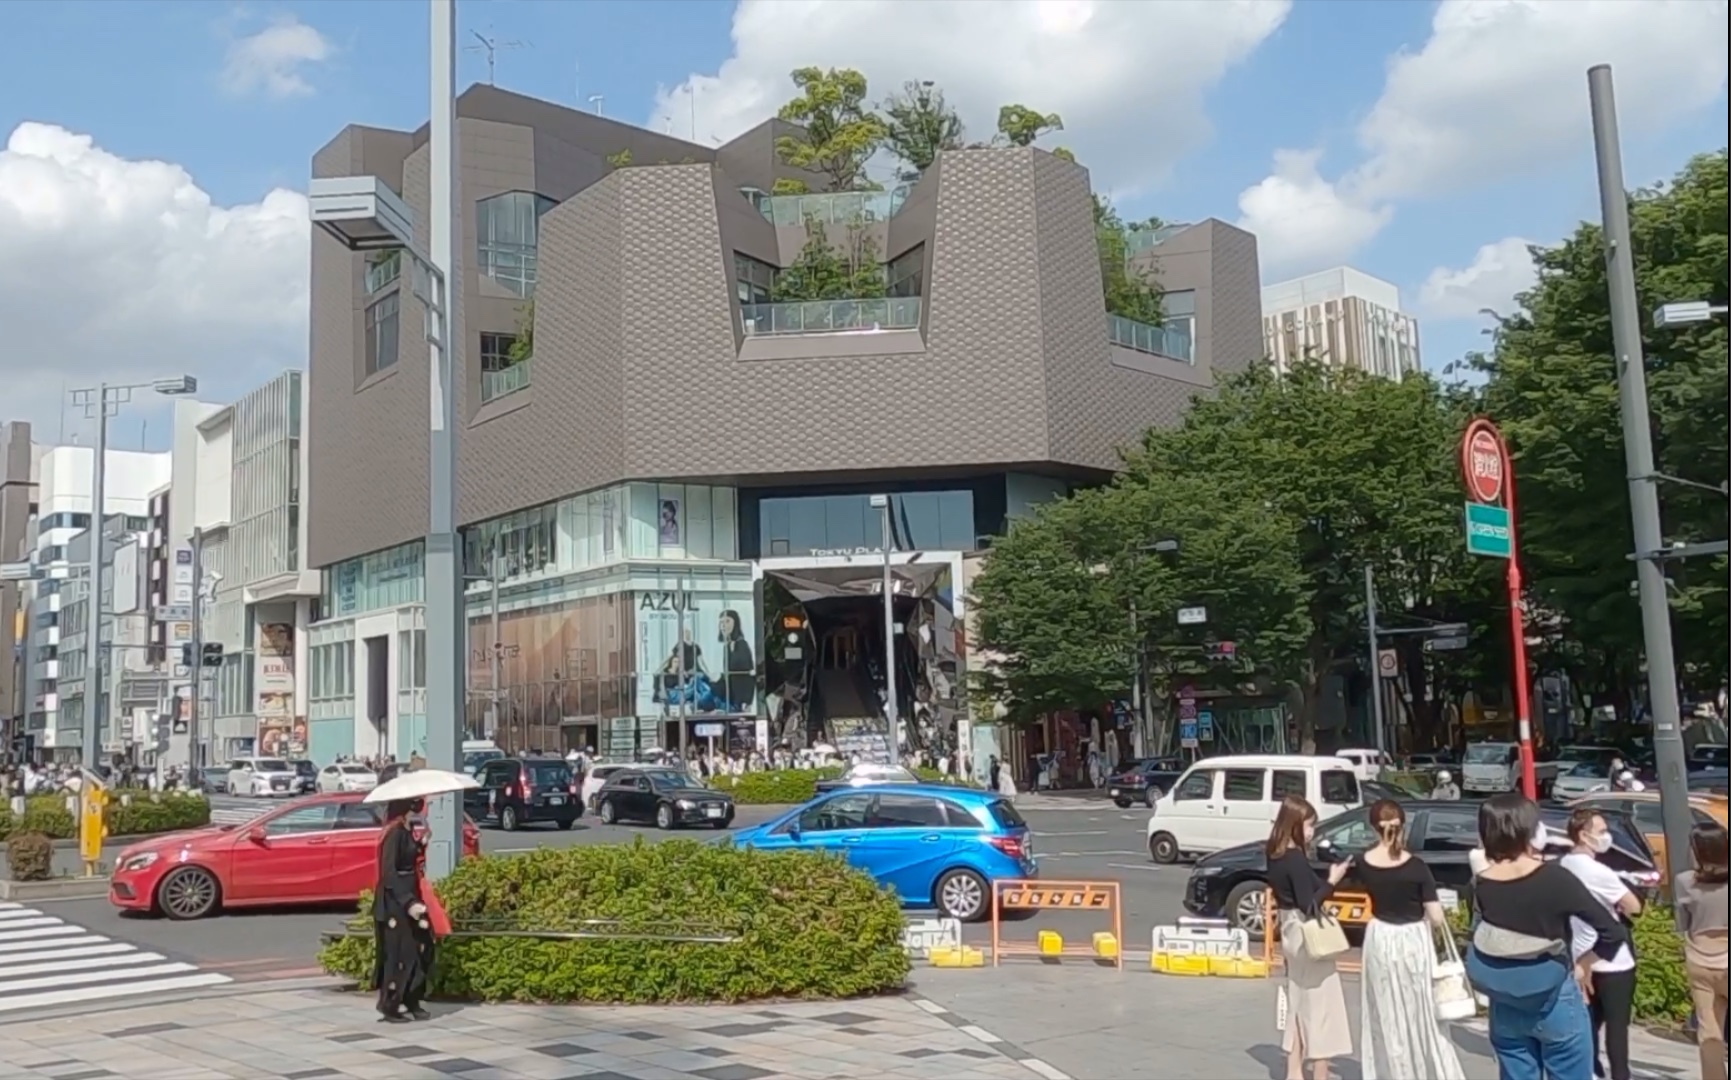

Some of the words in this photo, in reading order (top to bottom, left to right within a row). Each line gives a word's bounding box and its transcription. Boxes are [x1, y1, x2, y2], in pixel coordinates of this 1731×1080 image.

[809, 548, 852, 557] TOKYU
[855, 546, 899, 555] PLAA
[640, 592, 700, 611] AZUL
